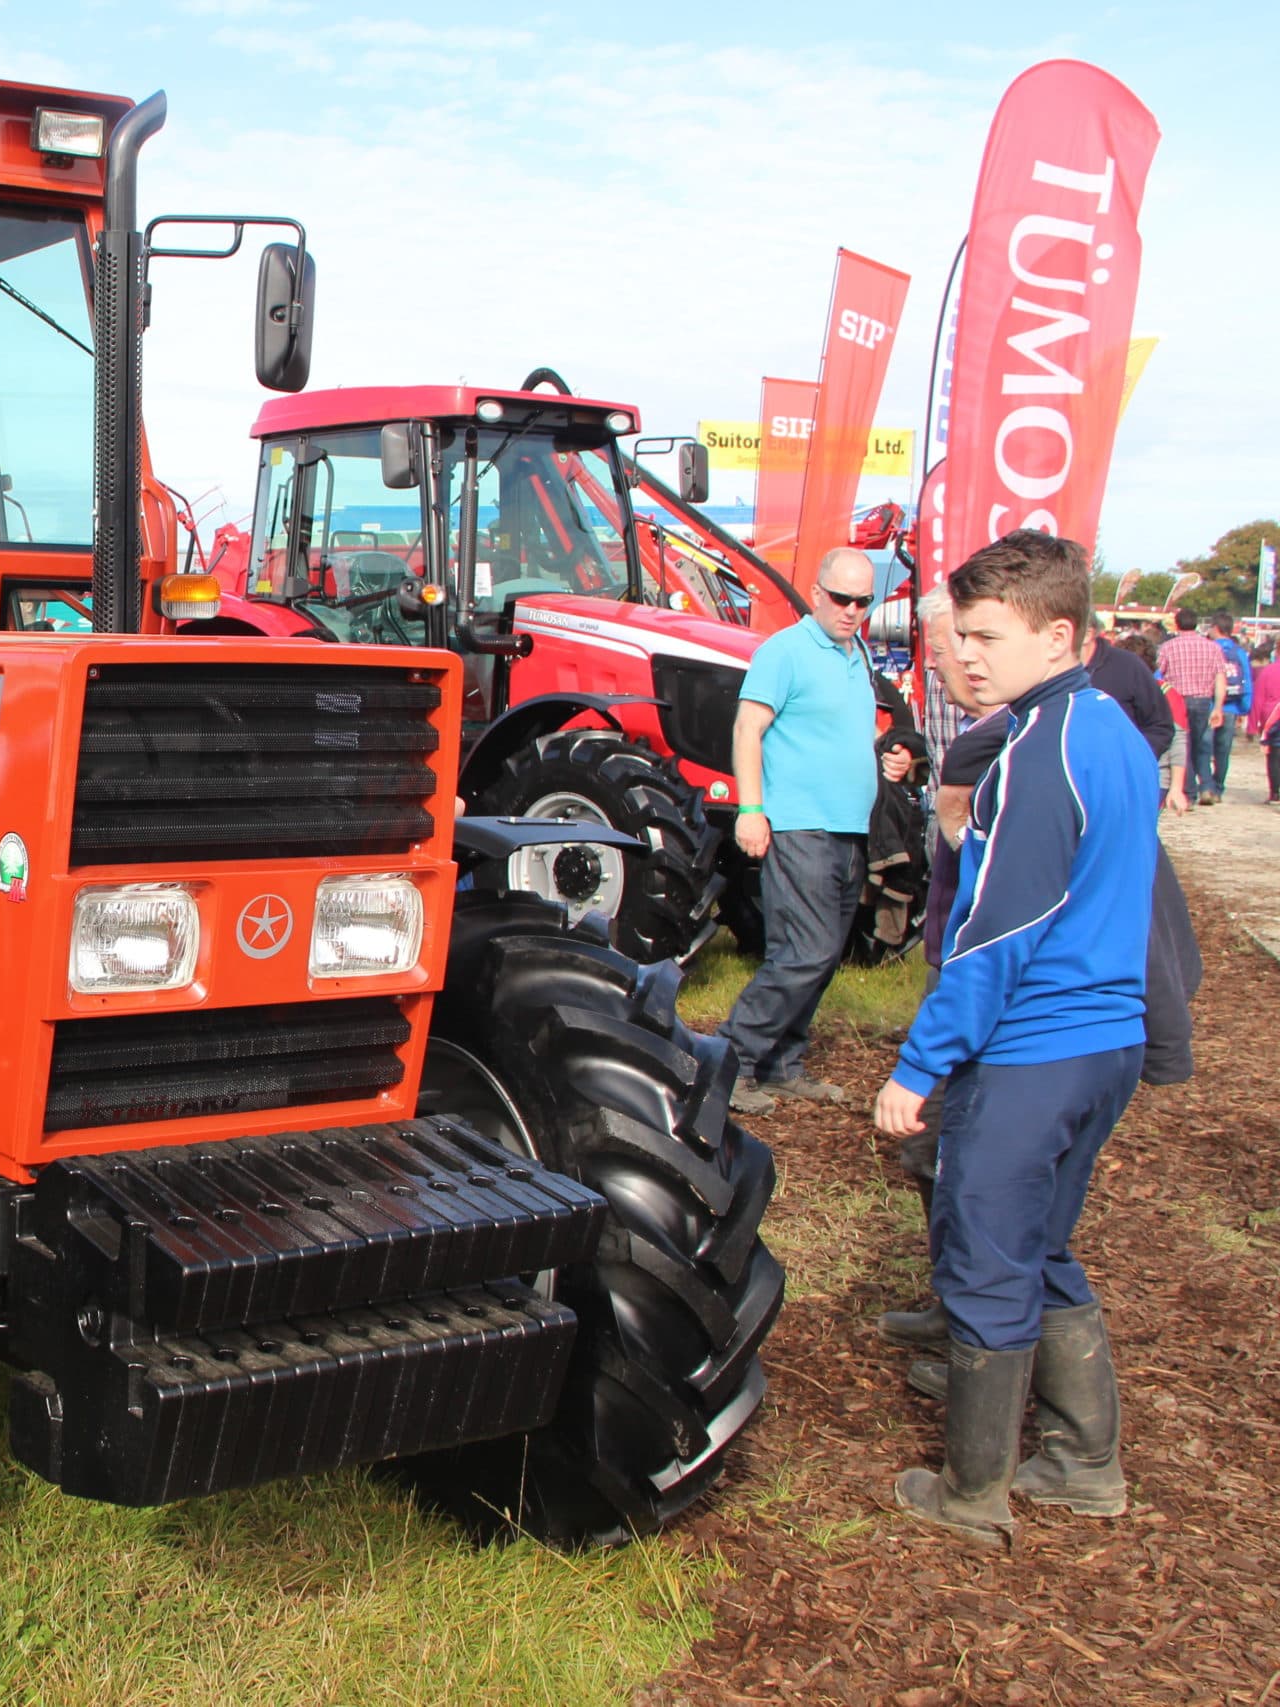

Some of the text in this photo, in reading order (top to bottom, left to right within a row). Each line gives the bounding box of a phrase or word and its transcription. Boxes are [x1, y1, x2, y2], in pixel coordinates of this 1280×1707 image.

[838, 308, 886, 350] SIP
[771, 416, 816, 439] SIP
[706, 432, 761, 449] Suitor
[874, 439, 905, 455] Ltd.
